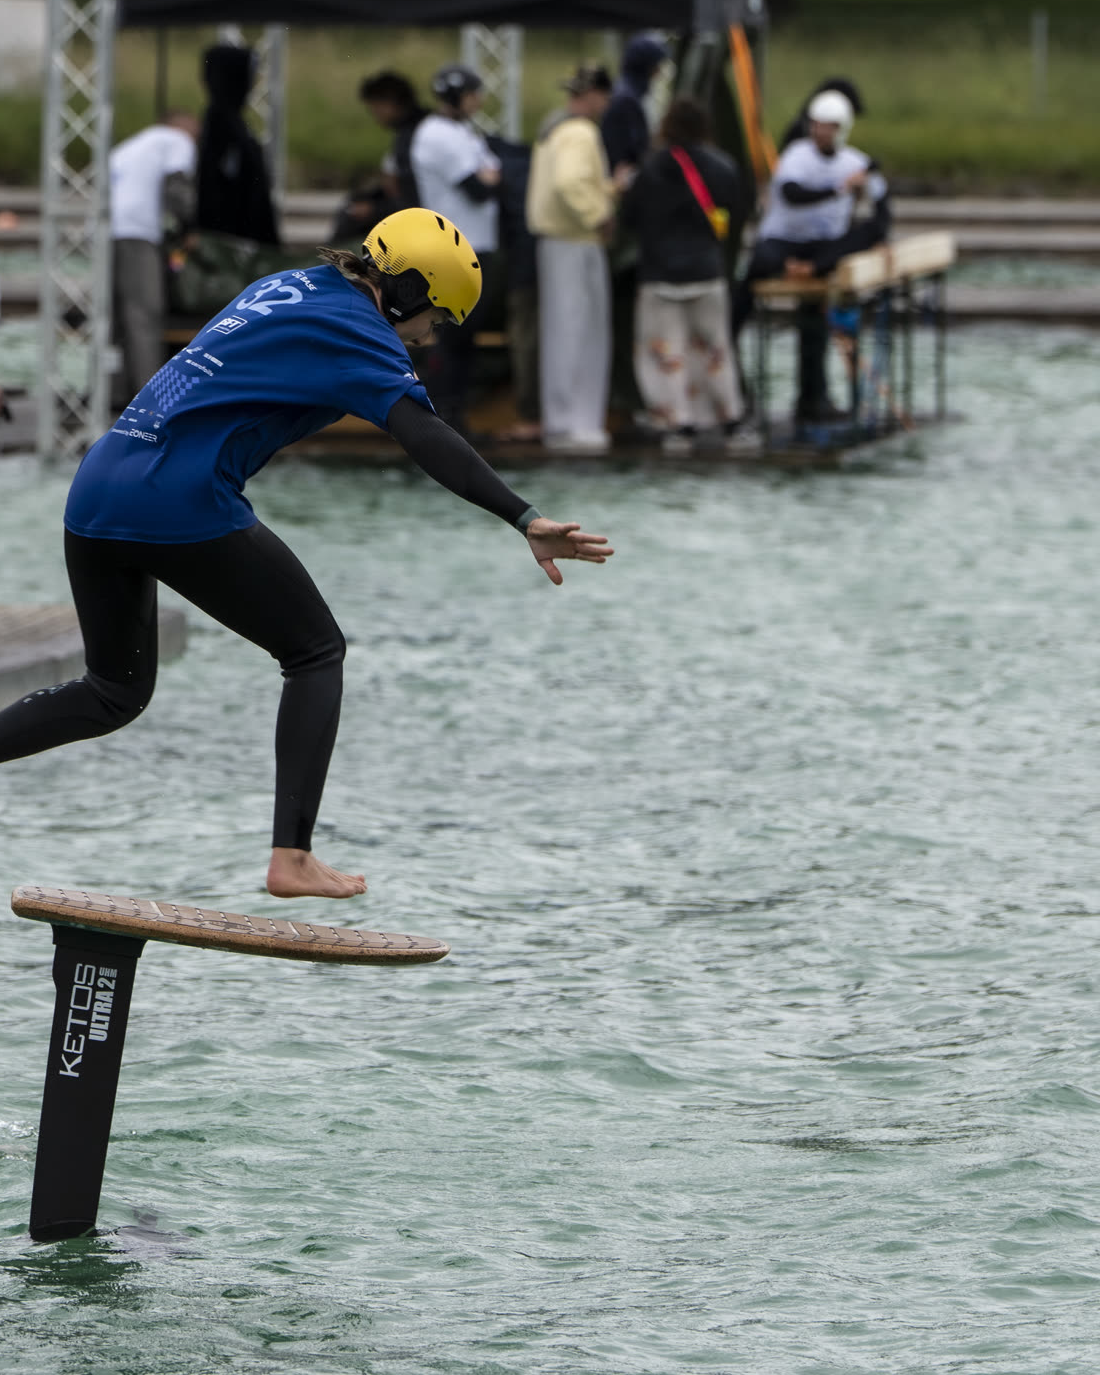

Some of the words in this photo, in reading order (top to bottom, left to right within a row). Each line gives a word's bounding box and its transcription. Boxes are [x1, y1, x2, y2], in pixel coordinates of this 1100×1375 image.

[236, 278, 304, 316] 32
[99, 966, 118, 978] UHM
[59, 963, 96, 1078] KETOS
